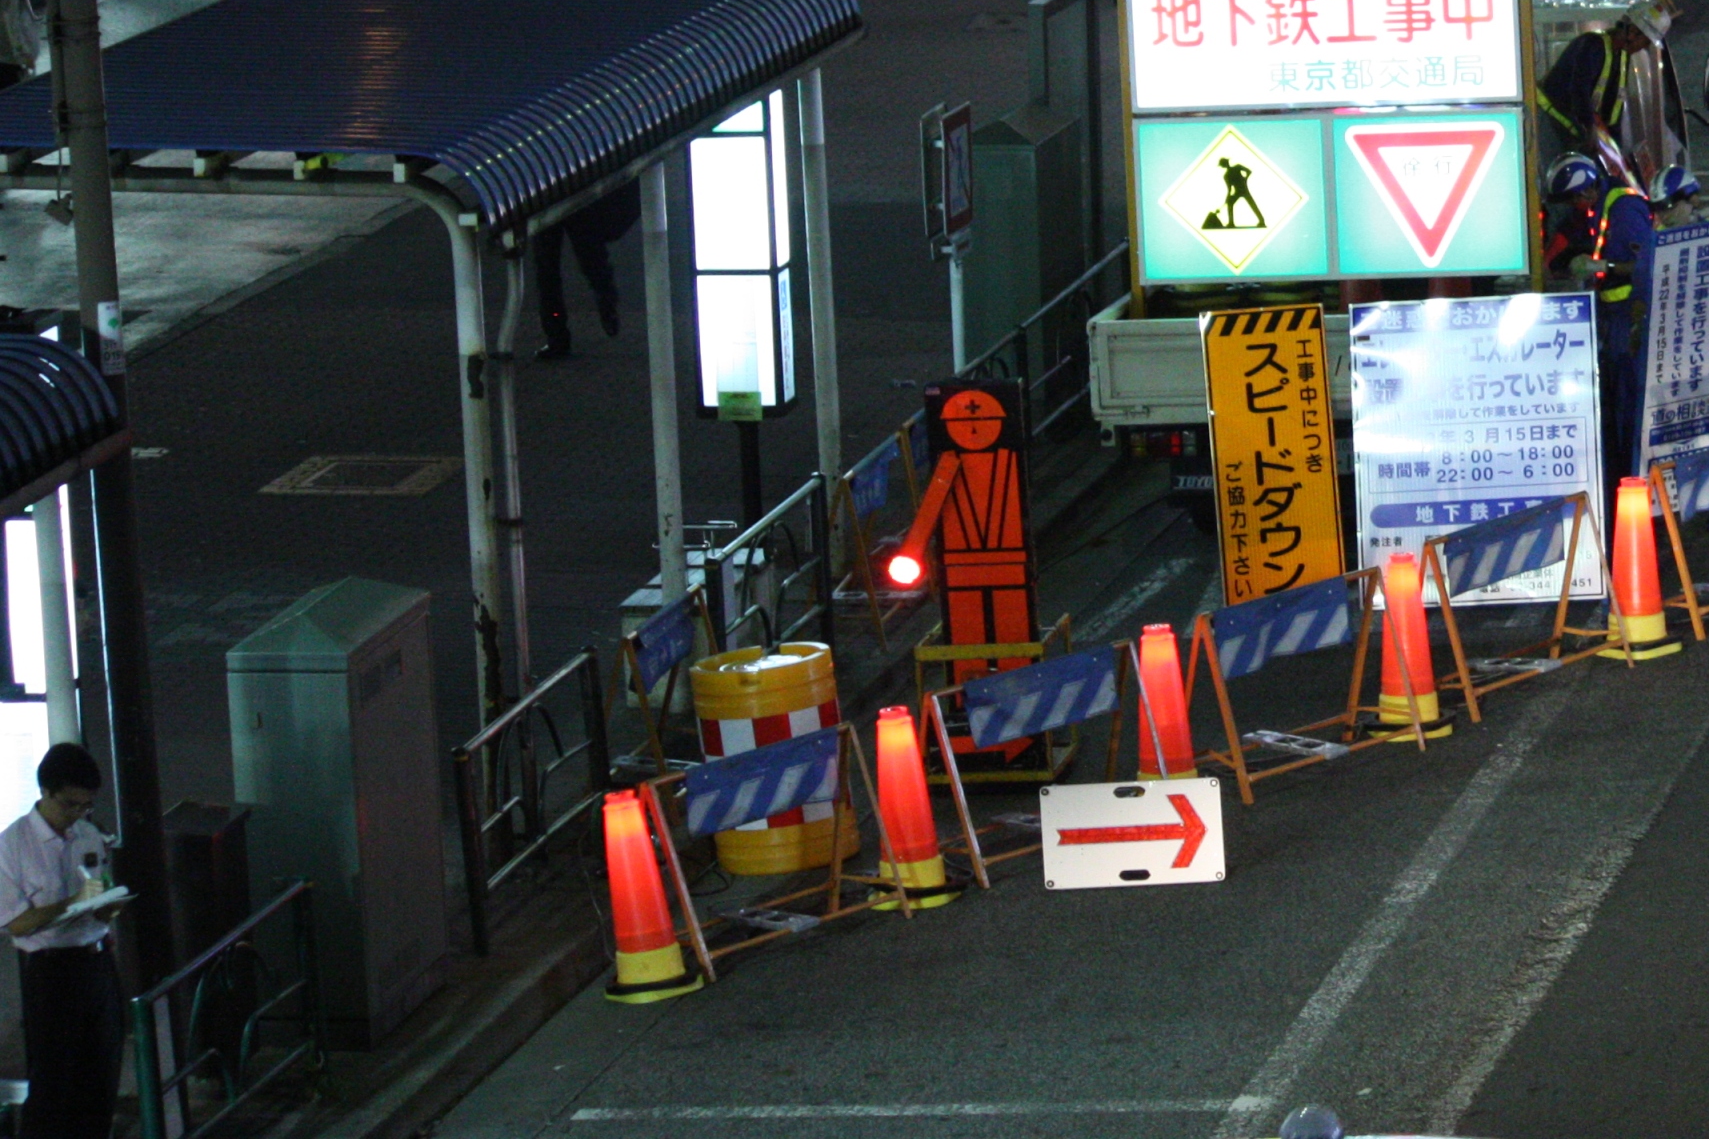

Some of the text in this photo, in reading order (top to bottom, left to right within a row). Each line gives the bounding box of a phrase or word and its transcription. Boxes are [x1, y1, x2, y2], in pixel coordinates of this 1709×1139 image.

[1269, 55, 1484, 92] 東京都交通局
[1296, 339, 1324, 473] 工事中につき
[1244, 342, 1305, 595] スピードダウン
[1378, 461, 1431, 479] 時間帯
[1225, 461, 1252, 598] ご協力下さい
[1369, 535, 1403, 548] 発注者
